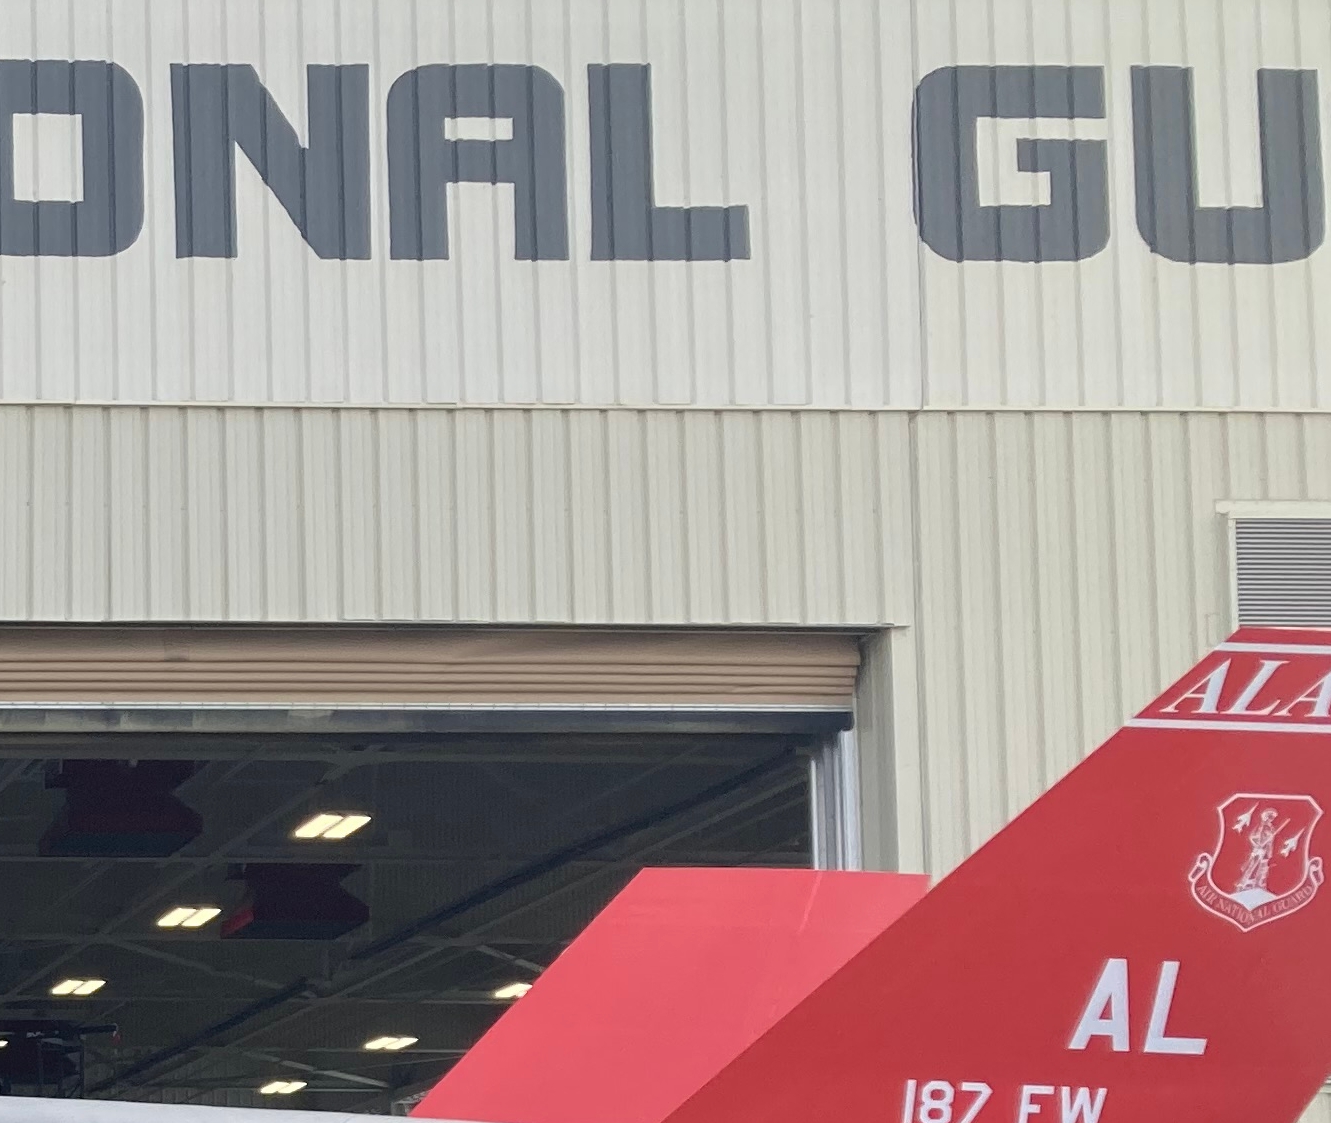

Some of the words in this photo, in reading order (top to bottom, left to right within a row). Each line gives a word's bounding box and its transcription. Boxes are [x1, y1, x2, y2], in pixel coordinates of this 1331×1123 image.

[912, 65, 1326, 264] GU
[1159, 658, 1331, 717] ALA
[1198, 885, 1218, 906] AIR
[1273, 884, 1315, 914] GUARD
[1068, 958, 1208, 1055] AL
